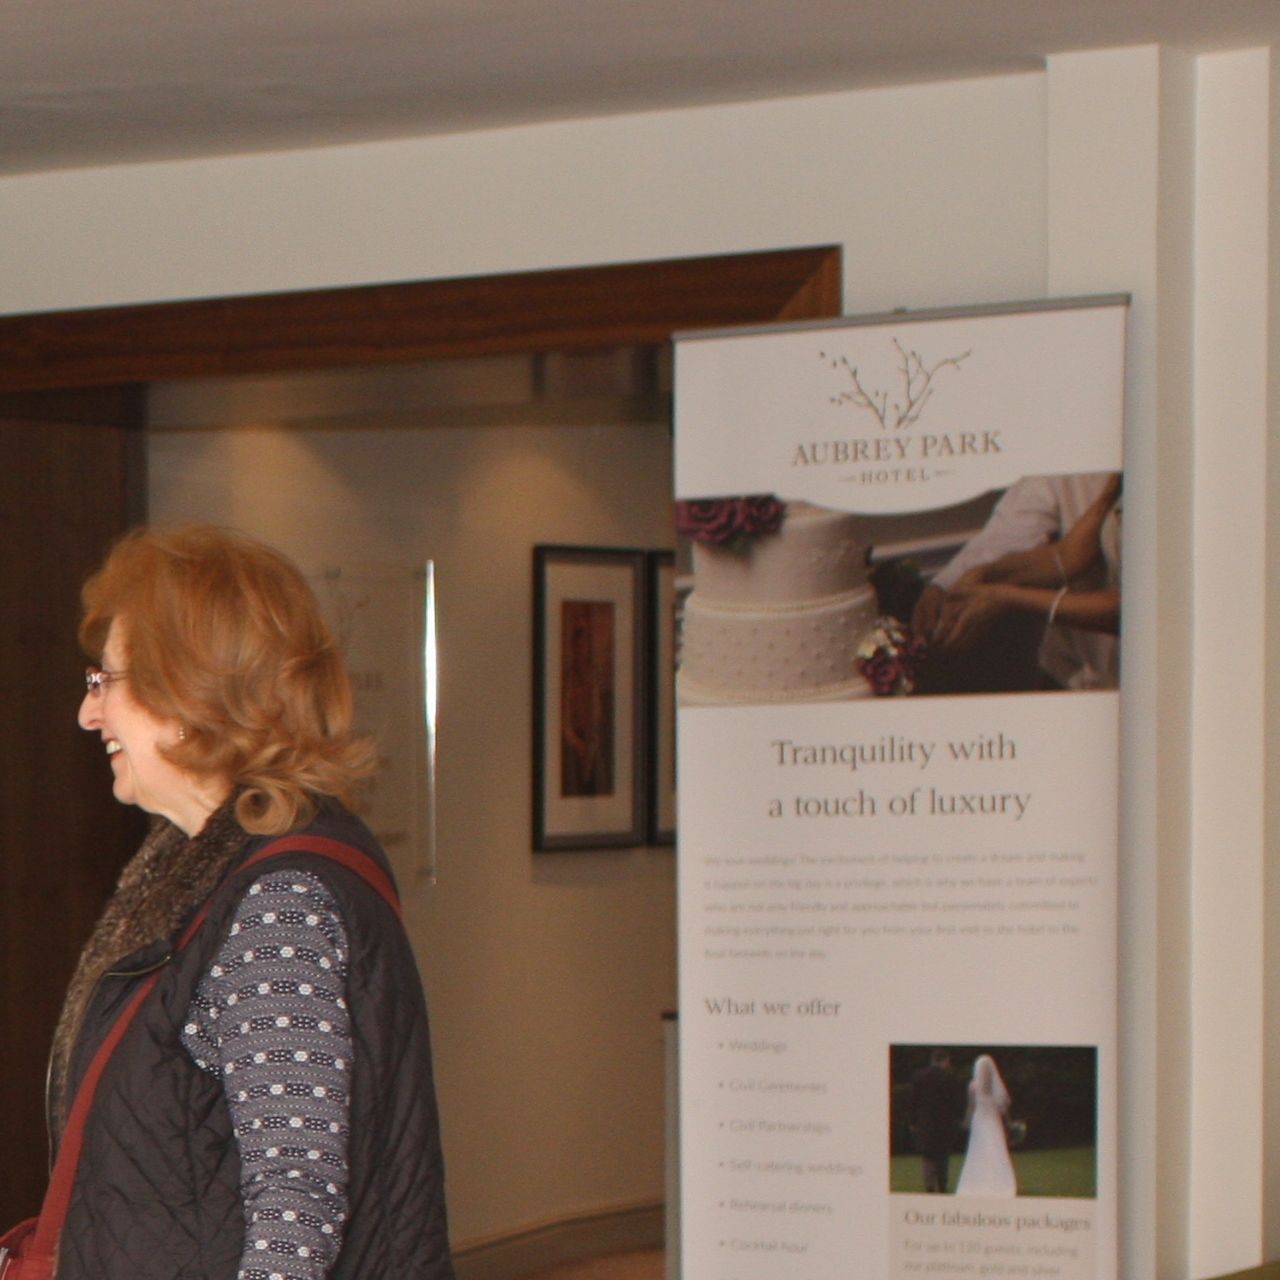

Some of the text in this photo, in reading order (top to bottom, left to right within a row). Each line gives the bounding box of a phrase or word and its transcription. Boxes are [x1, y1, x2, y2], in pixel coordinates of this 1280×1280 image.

[793, 429, 1002, 466] AUBREY PARK
[770, 731, 1017, 771] Tranquility with
[768, 786, 1032, 821] a touch of luxury
[704, 996, 841, 1016] What we offer
[904, 1209, 1091, 1232] Our fabulous packages
